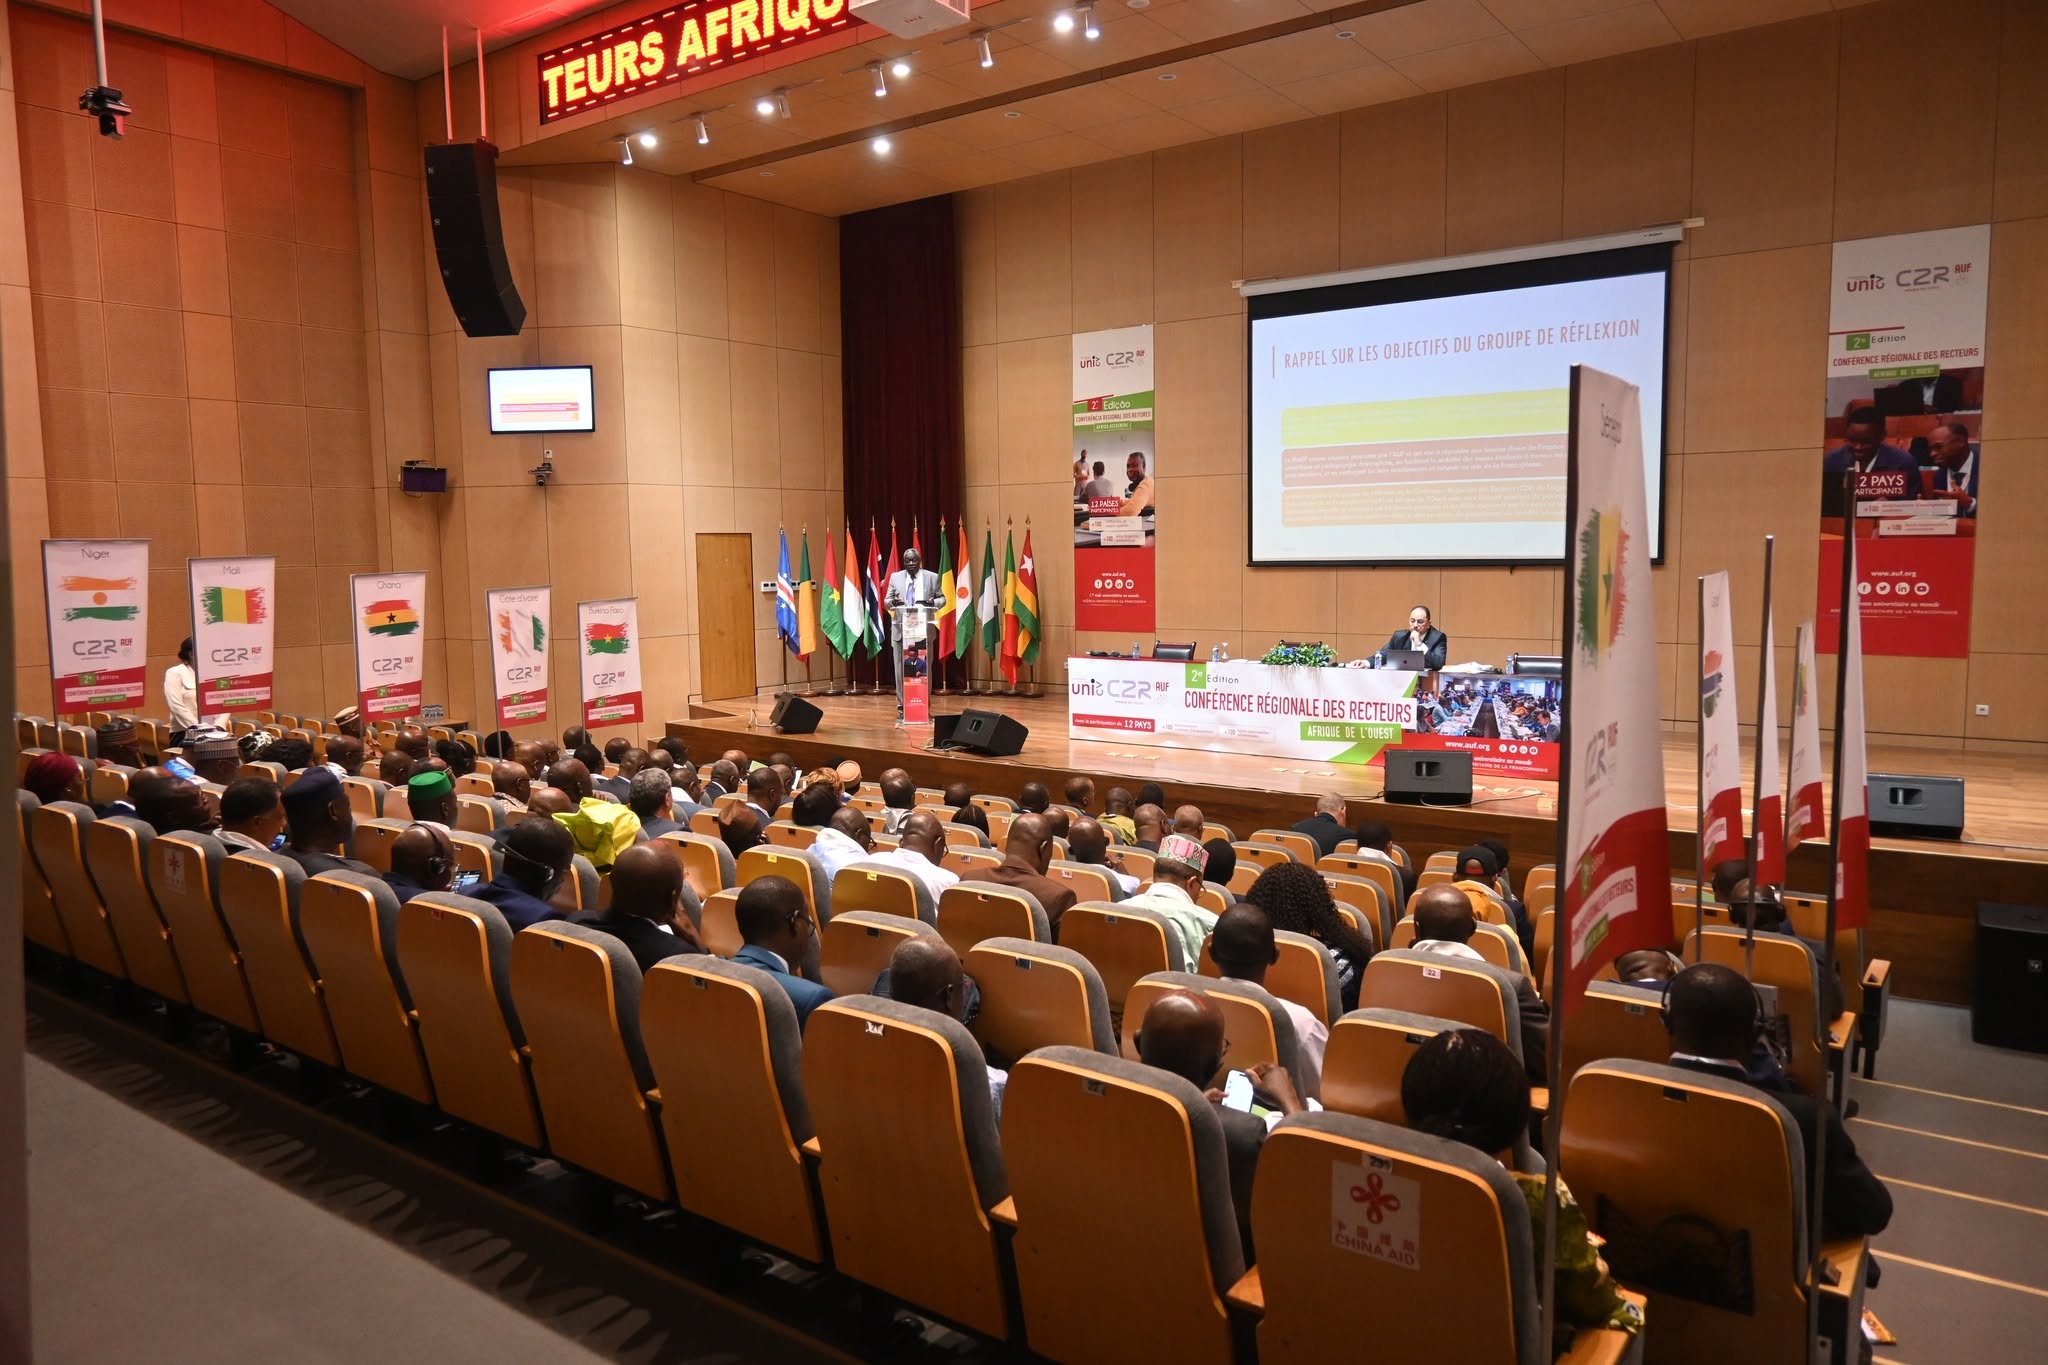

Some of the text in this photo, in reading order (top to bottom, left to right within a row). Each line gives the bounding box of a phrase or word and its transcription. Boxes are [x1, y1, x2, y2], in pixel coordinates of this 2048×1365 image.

[543, 31, 664, 108] TEURS
[1954, 263, 1972, 274] AUF
[1284, 319, 1641, 369] RAPPEL SUR LES OBJECTIFS DU GROUPE DE RÉFLEXION
[1871, 335, 1906, 344] Edition
[1833, 347, 1979, 367] CONFÉRENCE RÉGIONALE DES RECTEURS
[1871, 474, 1904, 486] PAYS
[1855, 487, 1903, 495] ARTICIPANTS
[1091, 499, 1119, 508] 12 PAÍSES
[82, 548, 110, 560] Niger
[223, 566, 241, 575] Mali
[1871, 570, 1916, 578] www.auf.org
[120, 638, 133, 647] AUF
[1207, 674, 1239, 684] Edition
[1155, 681, 1169, 692] AUF
[1184, 688, 1412, 723] CONFÉRENCE RÉGIONALE DES RECTEURS
[1124, 719, 1133, 728] 12
[1134, 720, 1152, 729] PAYS
[1307, 725, 1394, 740] AFRIQUE DE L'OUEST
[1445, 740, 1491, 751] www.auf.org
[1335, 1233, 1415, 1266] CHINA AID
